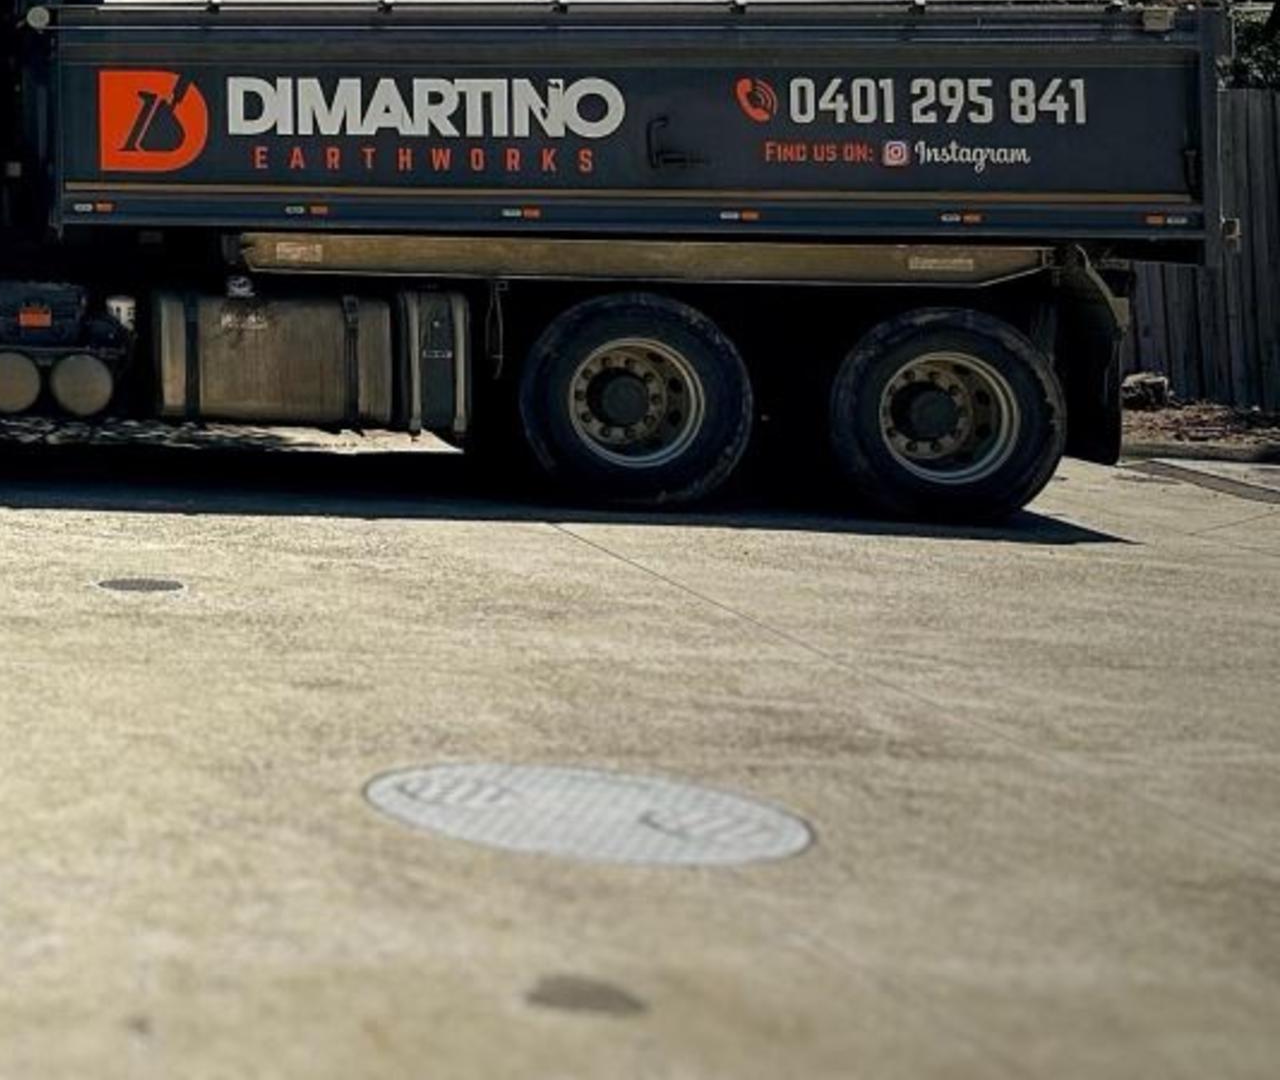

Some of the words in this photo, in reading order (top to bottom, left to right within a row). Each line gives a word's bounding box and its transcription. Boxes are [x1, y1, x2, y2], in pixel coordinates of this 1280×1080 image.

[227, 76, 626, 138] DIMARTINO
[790, 77, 895, 124] 0401
[910, 77, 993, 124] 295
[1010, 77, 1086, 124] 841
[253, 145, 594, 173] EARTHWORKS
[843, 142, 873, 162] ON:
[914, 140, 1031, 173] Instagram
